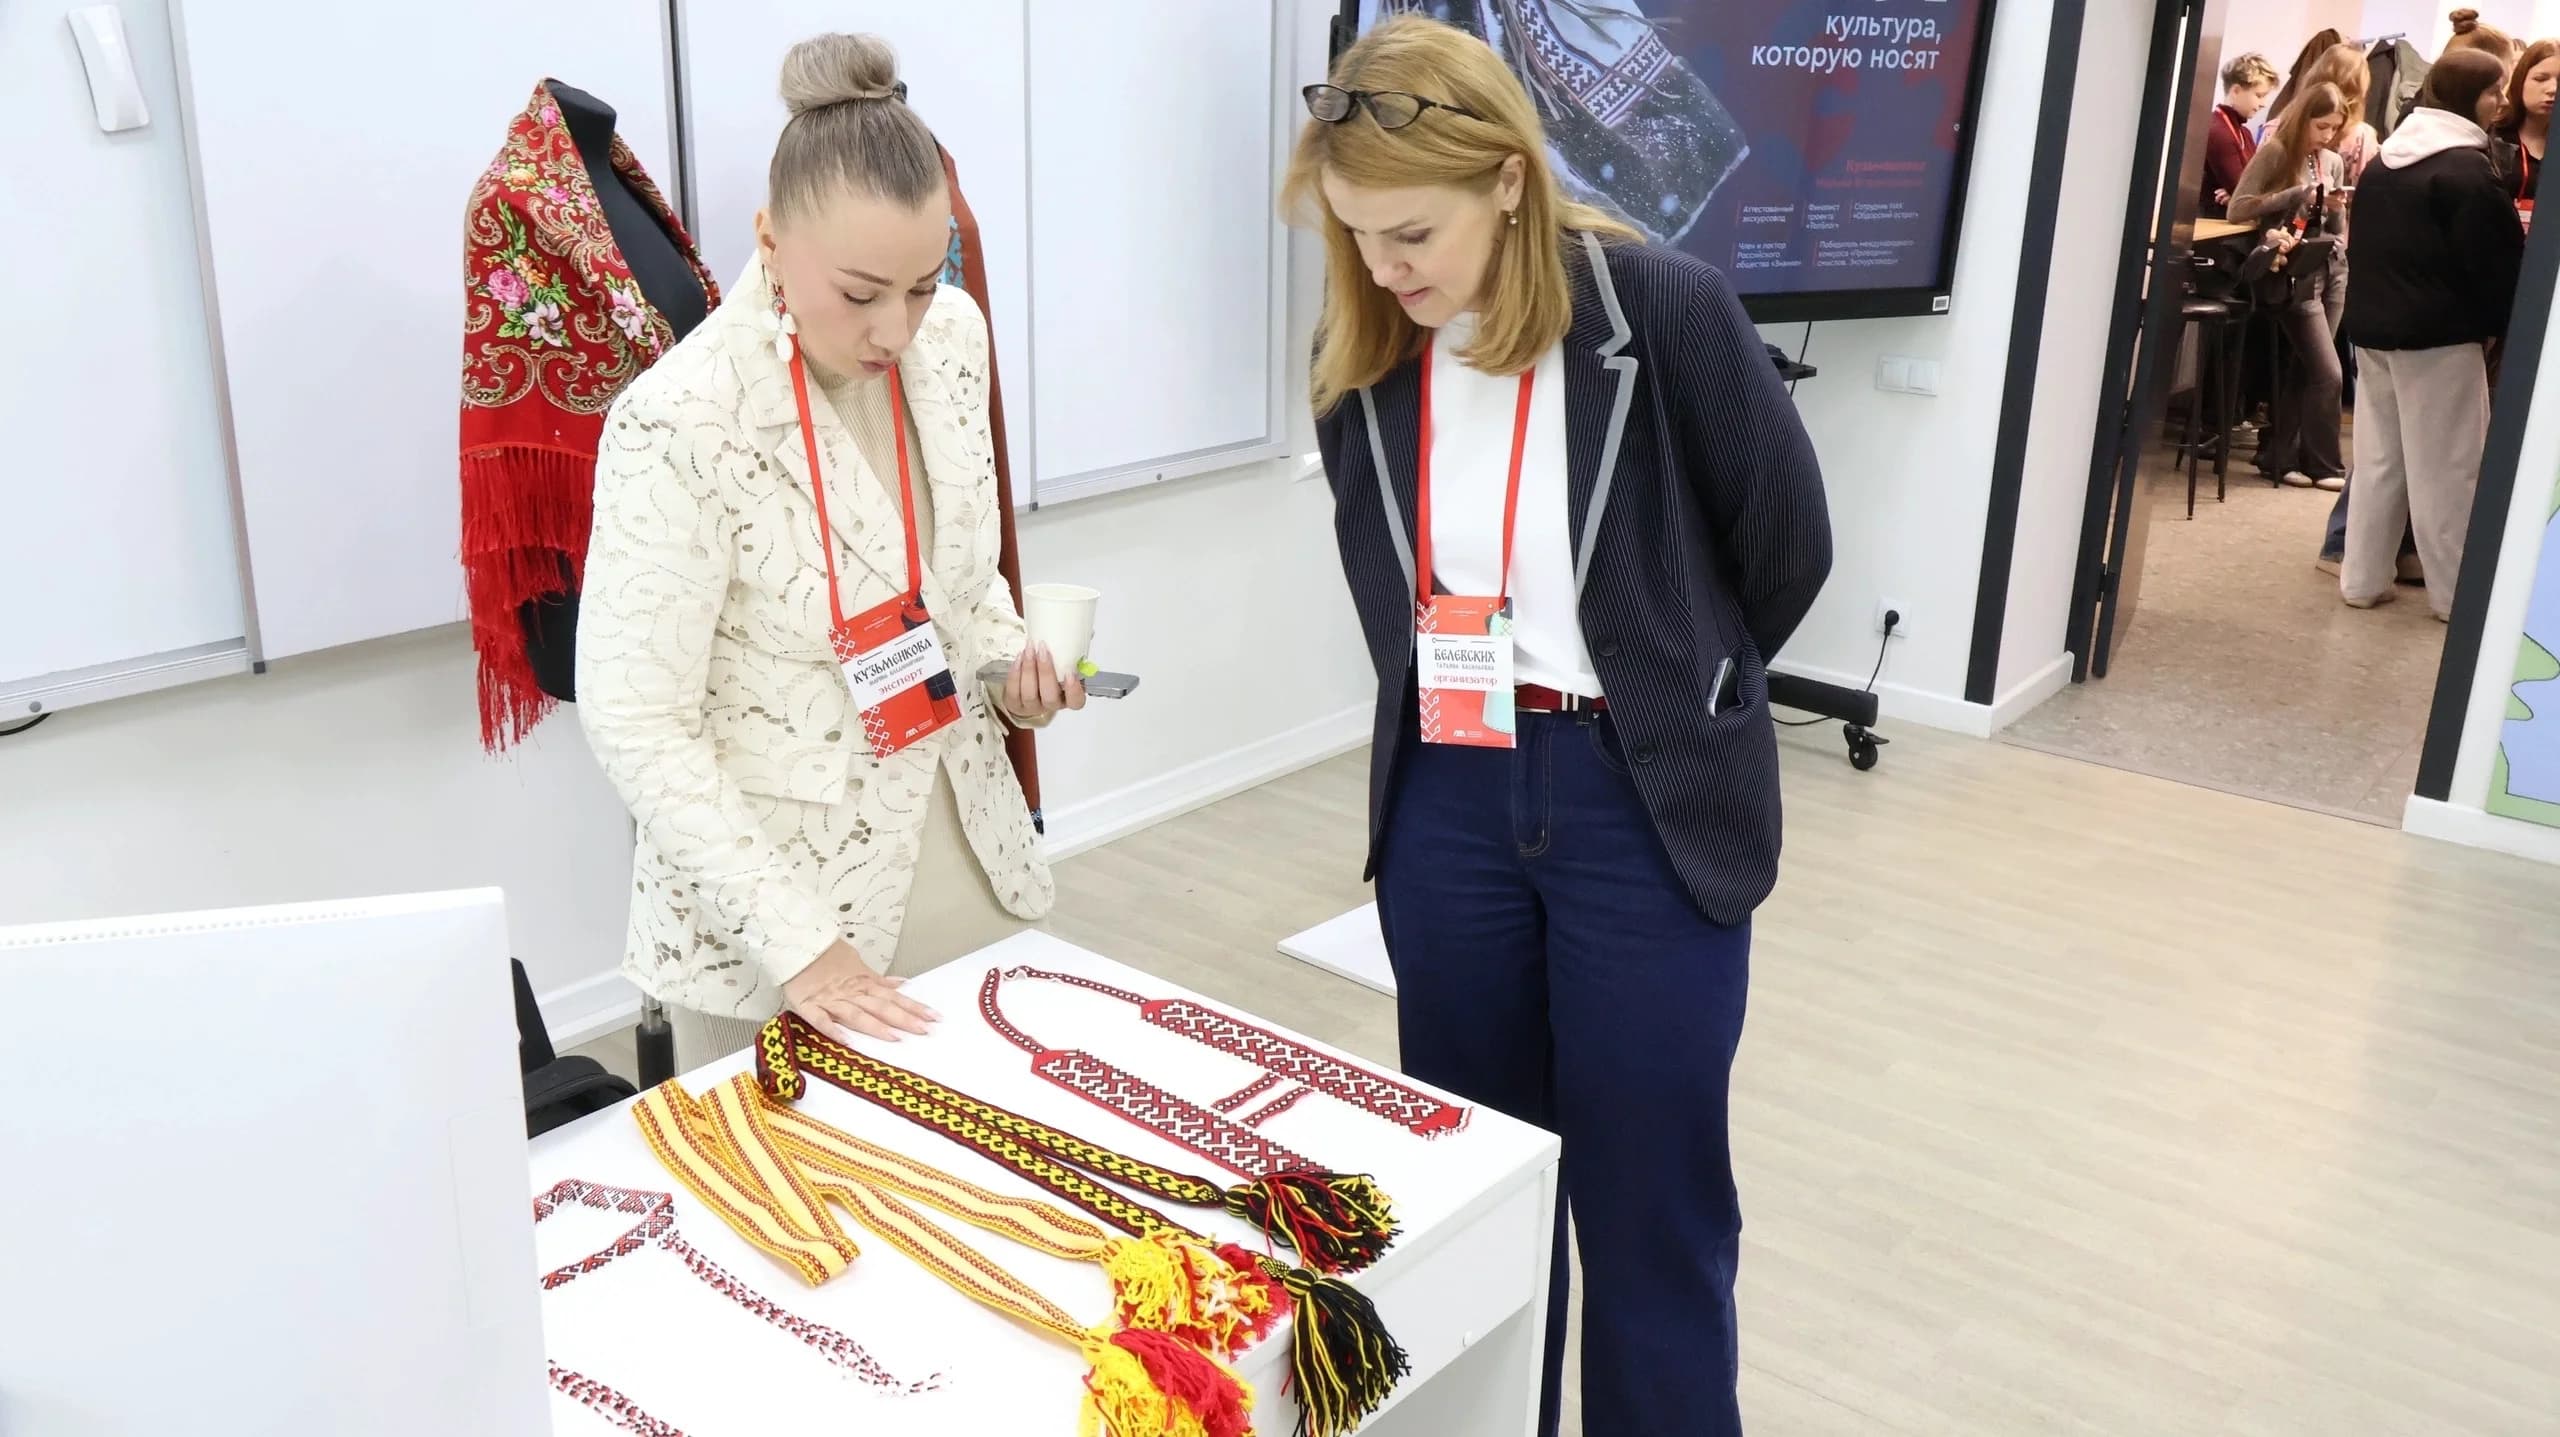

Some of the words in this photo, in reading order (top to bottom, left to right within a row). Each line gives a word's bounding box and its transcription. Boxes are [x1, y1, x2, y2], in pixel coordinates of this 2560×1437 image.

[1825, 15, 1942, 45] культура,
[1751, 45, 1862, 74] которую
[1869, 48, 1940, 70] носят
[853, 638, 933, 685] КУЗЬМЕНКОВА
[1434, 648, 1496, 663] БЕЛЕВСКИХ
[1433, 674, 1498, 687] организатор
